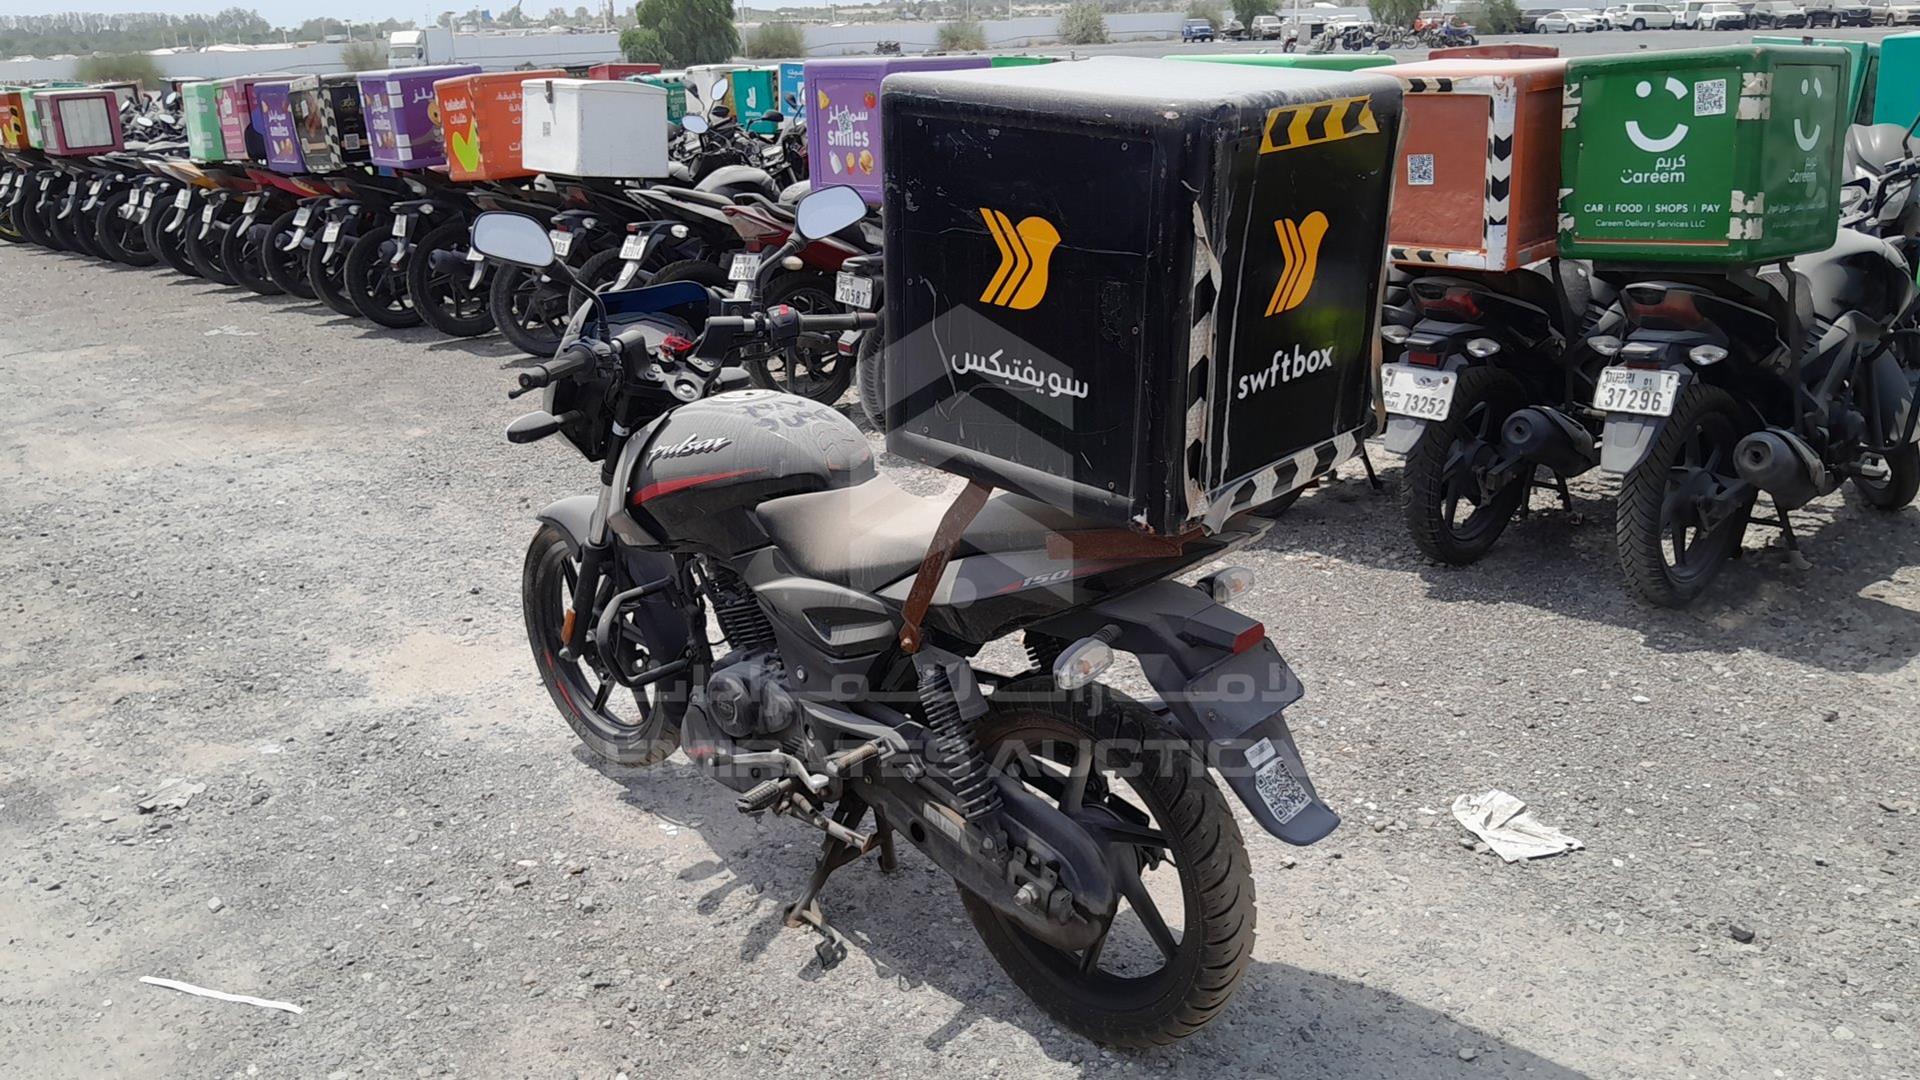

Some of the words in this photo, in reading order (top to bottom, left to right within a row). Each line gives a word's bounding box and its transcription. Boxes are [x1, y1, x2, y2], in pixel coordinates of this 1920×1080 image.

[827, 130, 870, 147] smiles
[1655, 154, 1686, 171] كريم
[1620, 169, 1685, 183] Careem
[1583, 203, 1604, 213] CAR
[1615, 203, 1643, 213] FOOD
[1655, 203, 1689, 213] SHOPS
[1701, 203, 1721, 213] PAY
[1595, 219, 1624, 227] Careem
[1625, 219, 1655, 229] Delivery
[1657, 219, 1689, 228] Services
[1690, 219, 1706, 228] LLC
[840, 287, 866, 306] 20587
[951, 349, 1089, 398] سويفتبكس
[1237, 344, 1334, 400] swftbox
[1403, 393, 1446, 416] 73252
[1605, 387, 1663, 411] 37296
[1022, 570, 1071, 587] 150
